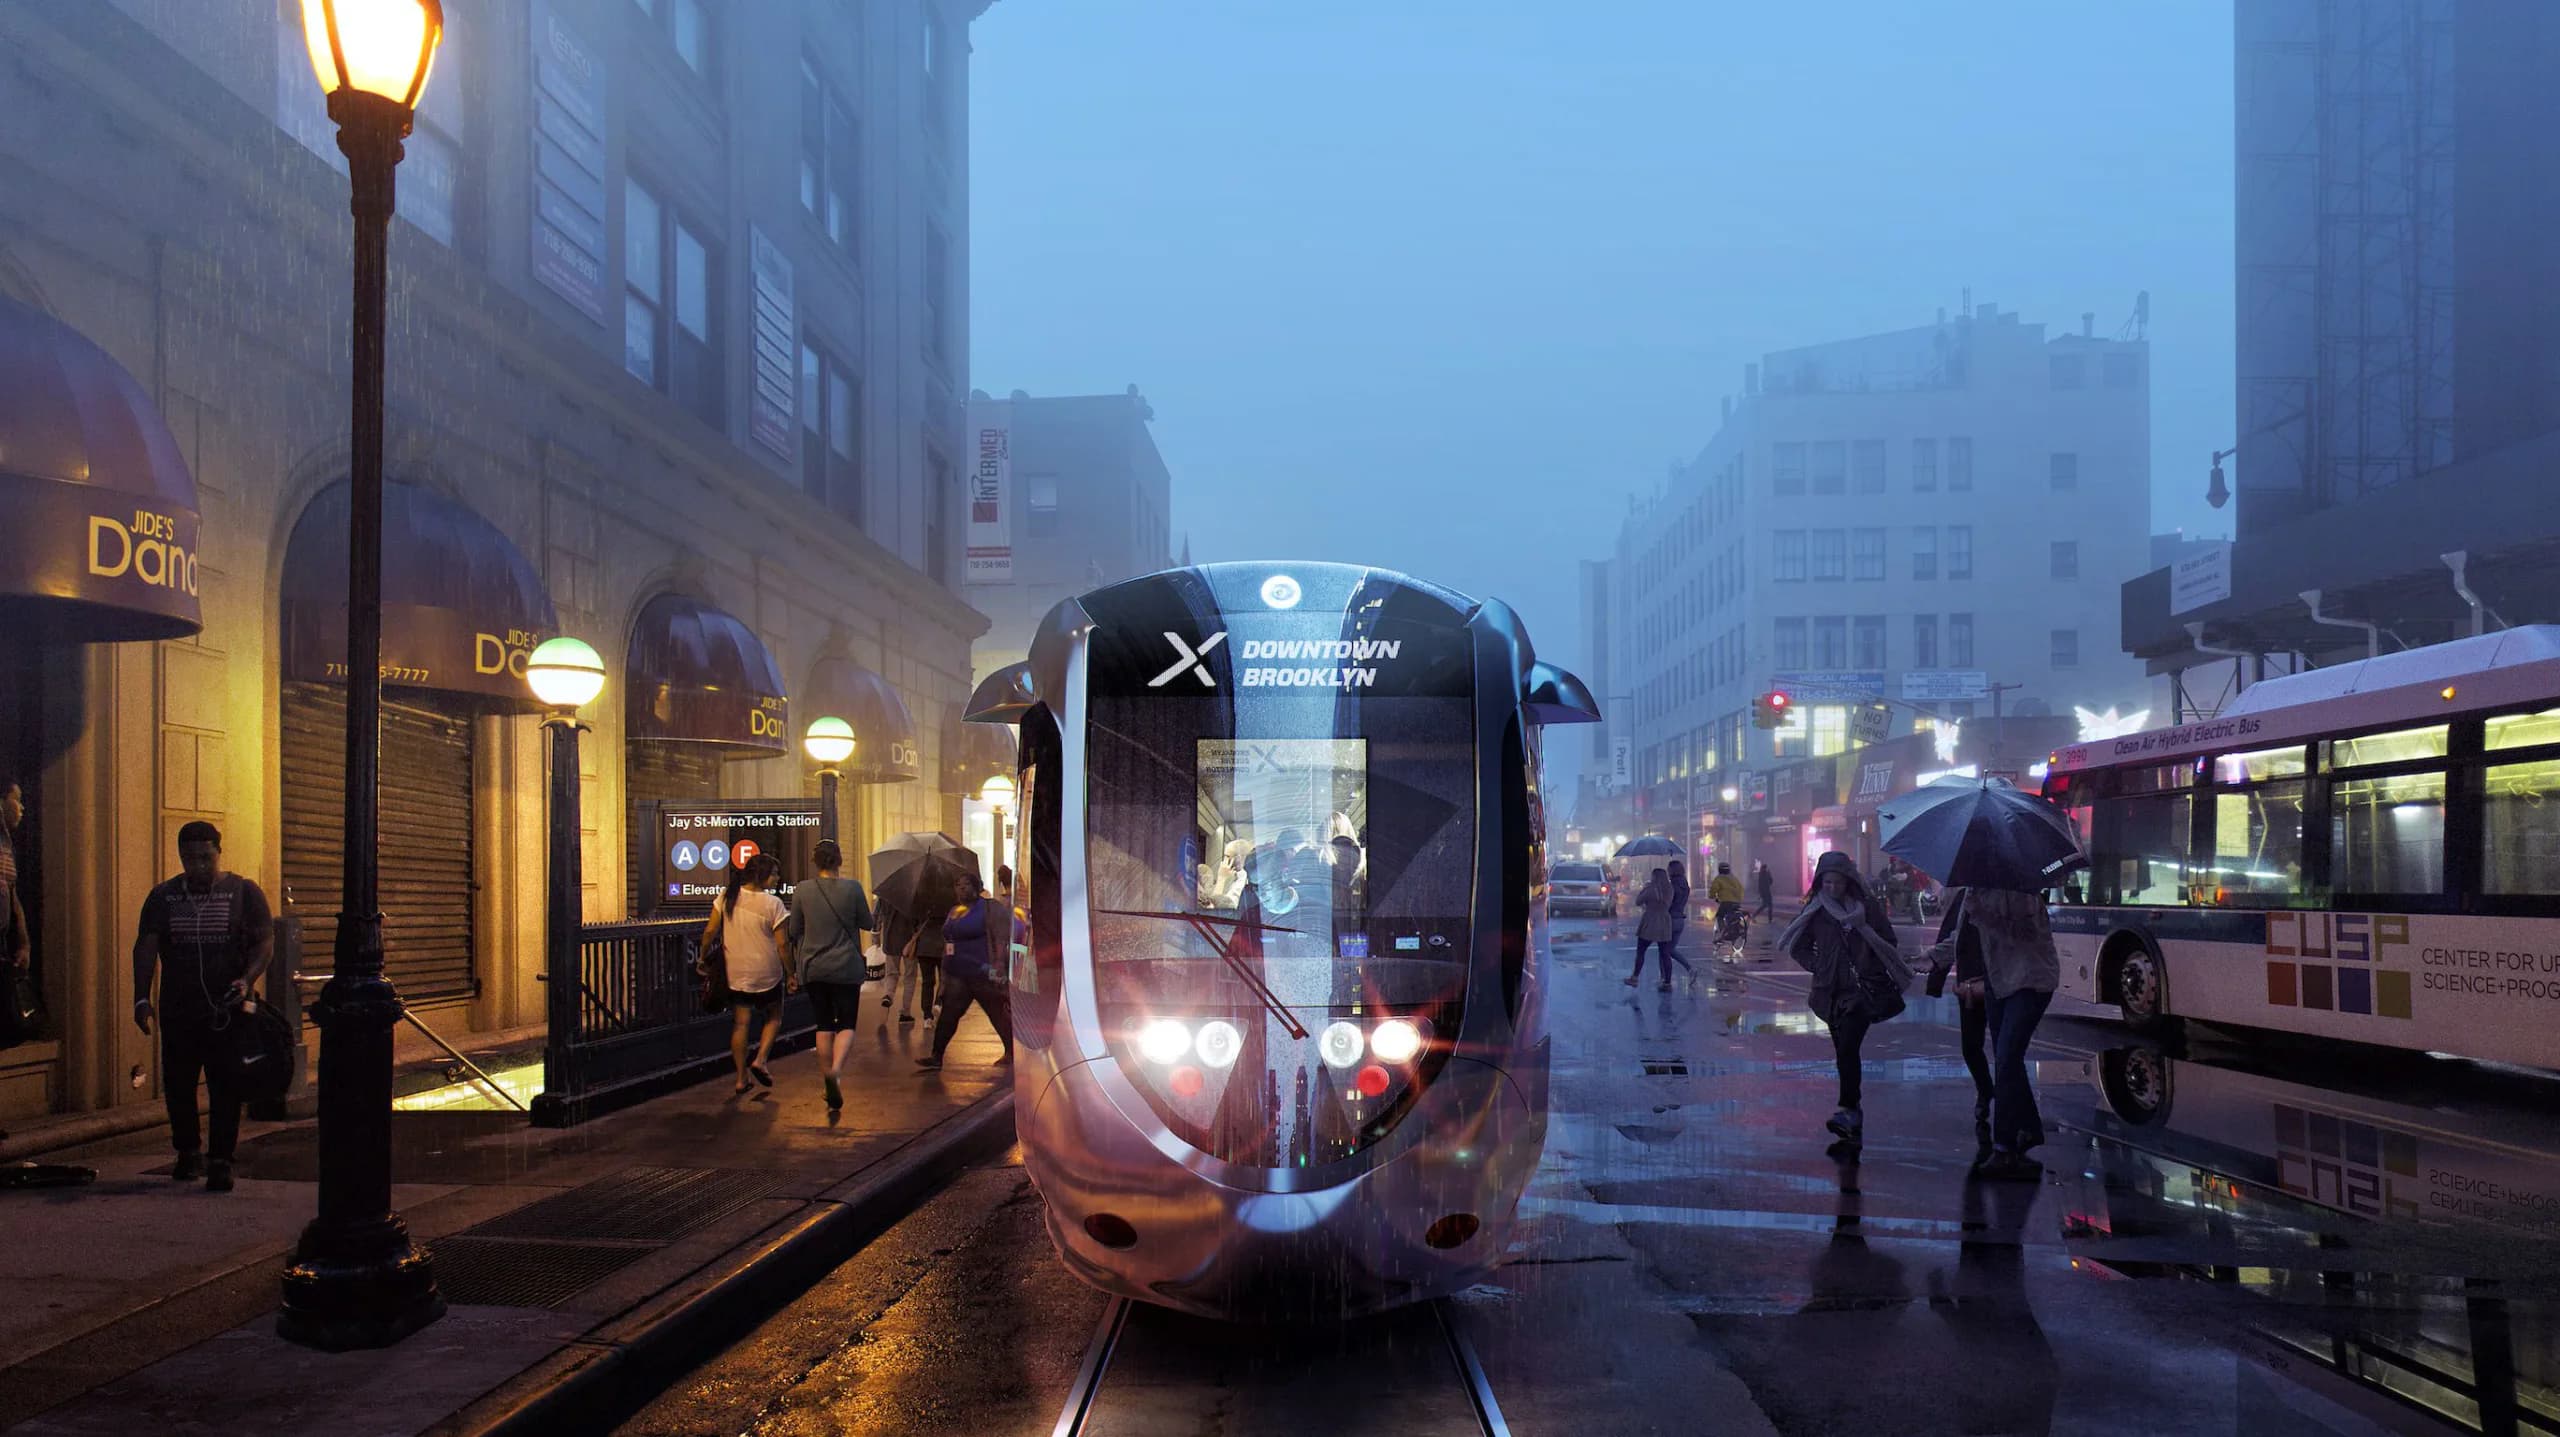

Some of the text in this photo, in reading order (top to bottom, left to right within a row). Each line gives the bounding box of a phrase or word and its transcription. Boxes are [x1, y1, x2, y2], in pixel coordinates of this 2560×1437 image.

[130, 510, 175, 541] JIDE'S
[1242, 640, 1402, 659] DOWNTOWN
[1241, 667, 1378, 687] BROOKLYN
[1864, 711, 1882, 725] NO
[1853, 724, 1887, 740] TURNS
[2065, 718, 2261, 764] 3990 Clean Air Hybrid Electric Bus
[669, 814, 820, 830] Jay St-MetroTech Station
[677, 846, 753, 867] A C F
[780, 883, 796, 895] Ja
[2265, 911, 2410, 963] CUSP
[2422, 948, 2493, 969] CENTER
[2496, 951, 2535, 973] FOR
